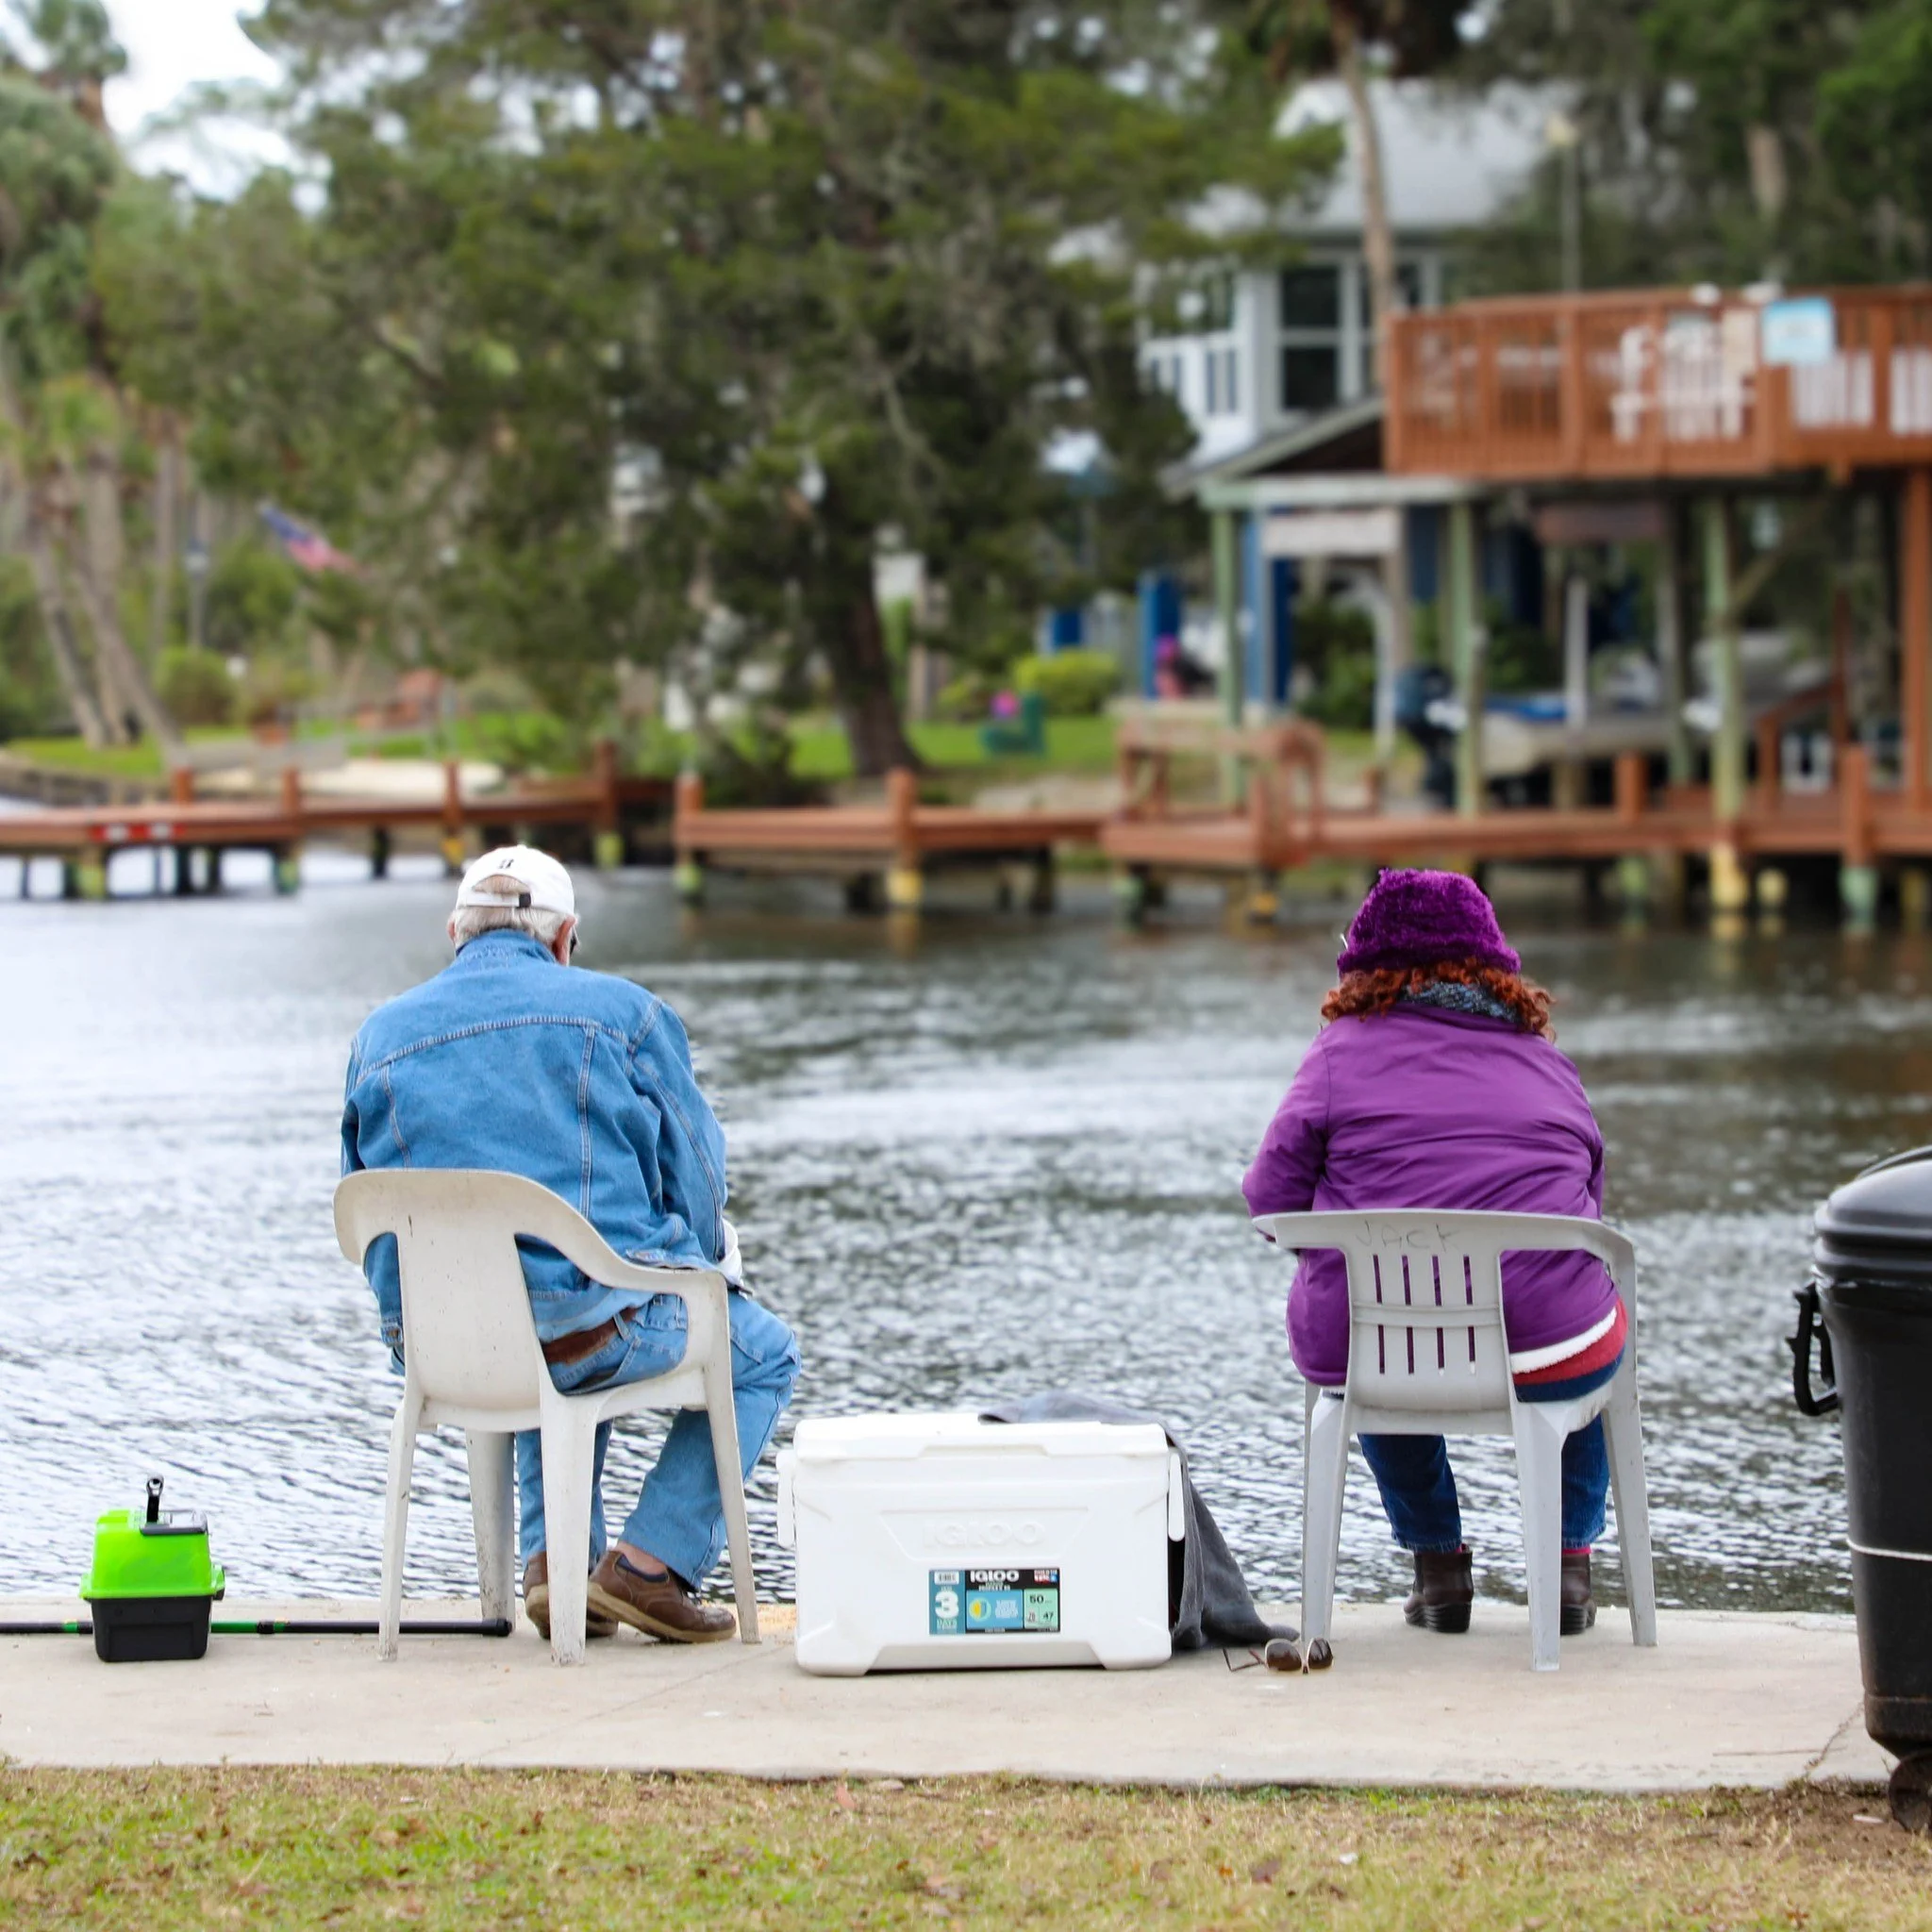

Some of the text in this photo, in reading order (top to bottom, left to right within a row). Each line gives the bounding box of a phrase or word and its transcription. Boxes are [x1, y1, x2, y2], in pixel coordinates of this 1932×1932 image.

[1356, 1220, 1460, 1252] JACK
[923, 1520, 1046, 1549] IGLOO
[970, 1570, 1020, 1582] IGLOO
[935, 1591, 959, 1619] 3
[1029, 1594, 1044, 1604] 50
[1042, 1611, 1054, 1622] 47
